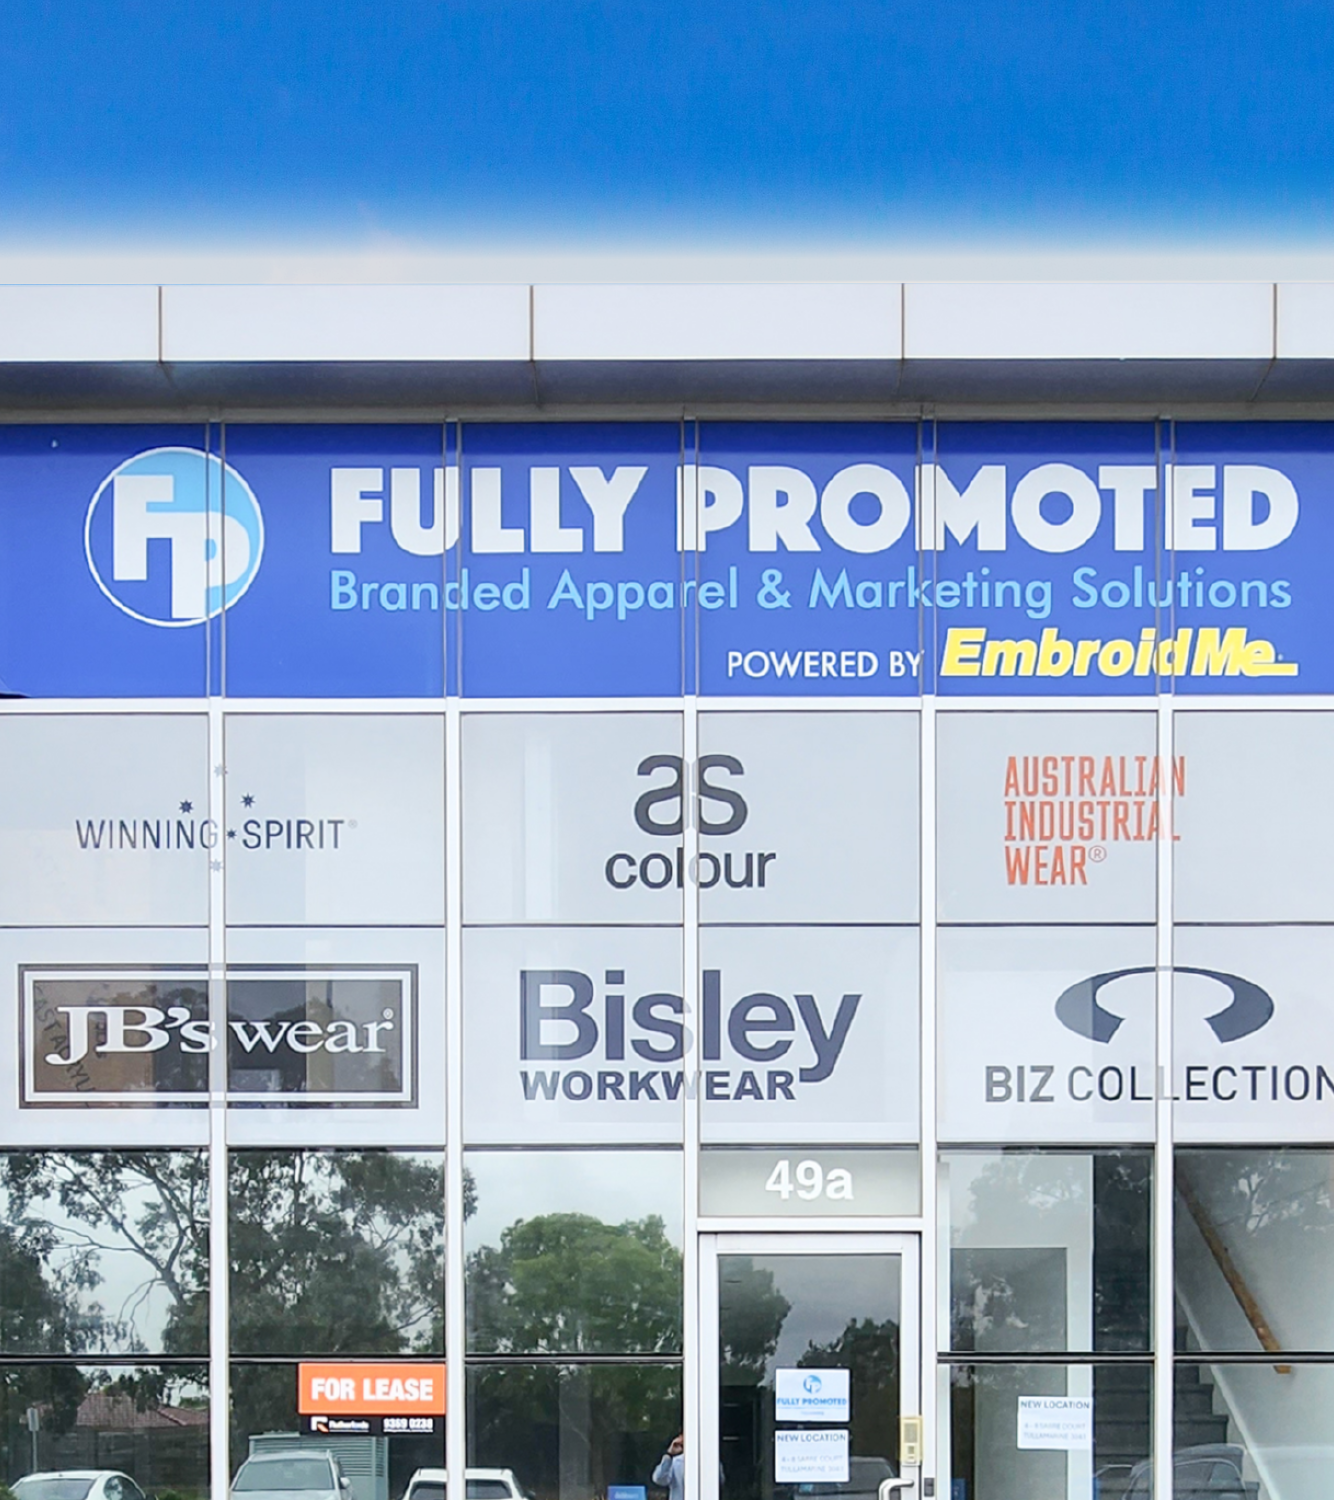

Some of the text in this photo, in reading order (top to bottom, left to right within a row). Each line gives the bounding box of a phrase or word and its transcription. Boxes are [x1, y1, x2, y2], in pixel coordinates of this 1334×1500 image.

[331, 463, 1299, 556] FULLY PROMOTED
[331, 565, 1292, 621] Branded Apparel & Marketing Solutions
[727, 651, 879, 679] POWERED
[889, 650, 924, 678] BY
[1003, 755, 1187, 797] AUSTRALIAN
[75, 819, 218, 850] WINNING
[1003, 801, 1182, 842] INDUSTRIAL
[605, 848, 776, 889] colour
[45, 1006, 218, 1065] JB's
[519, 969, 863, 1081] Bisley
[519, 1069, 797, 1101] WORKWEAR
[984, 1065, 1055, 1103] BIZ
[765, 1160, 855, 1200] 49a
[311, 1377, 433, 1401] FOR LEASE
[1021, 1401, 1090, 1409] NEW LOCATION
[777, 1434, 846, 1442] NEW LOCATION
